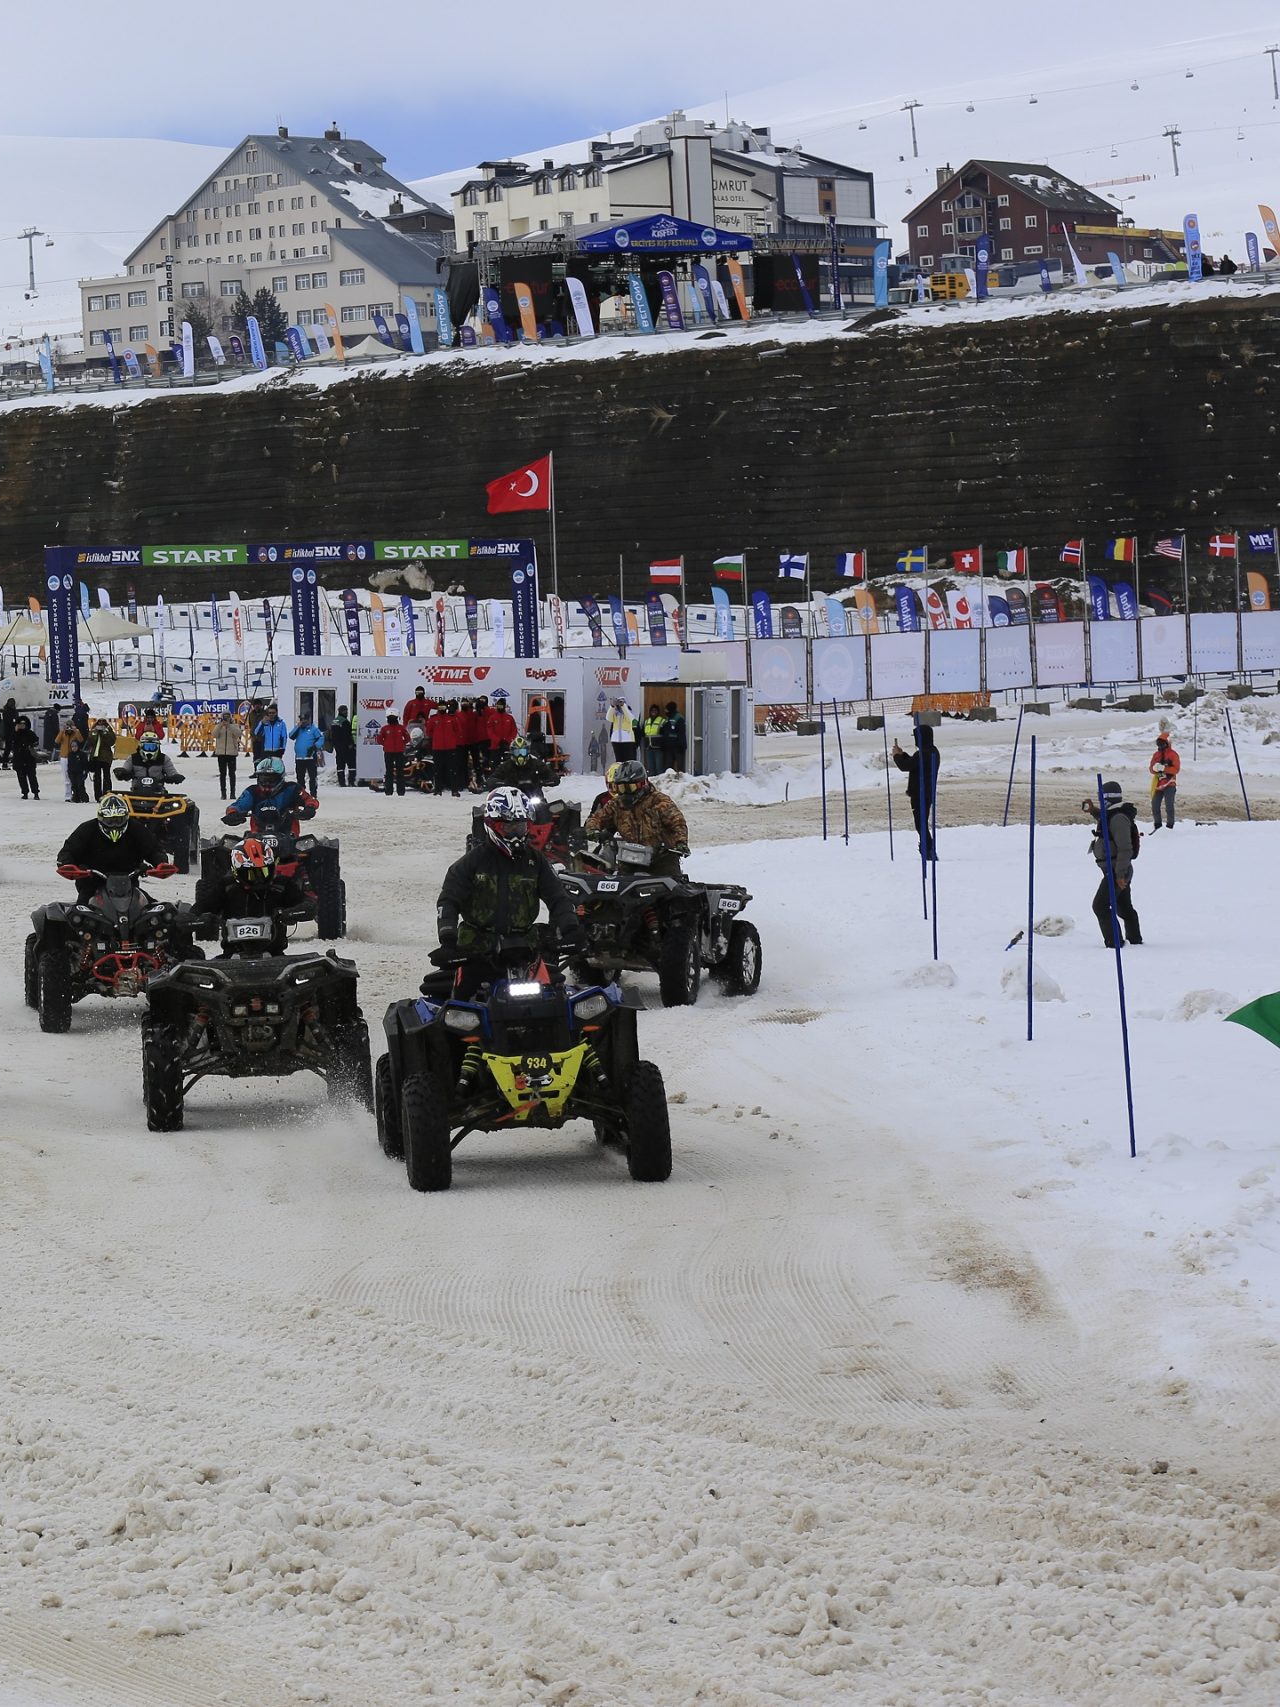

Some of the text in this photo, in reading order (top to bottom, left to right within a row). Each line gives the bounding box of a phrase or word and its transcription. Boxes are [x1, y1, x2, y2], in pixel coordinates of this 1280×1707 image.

[713, 179, 747, 191] ÜMRÜT
[315, 546, 341, 557] SNX
[383, 545, 460, 559] START
[497, 543, 520, 554] SNX
[112, 550, 140, 562] SNX
[152, 549, 238, 564] START
[293, 665, 333, 677] TÜRKİYE
[440, 668, 469, 680] TMF
[525, 667, 558, 682] Erciyes
[603, 669, 620, 682] TMF
[600, 882, 616, 890] 866
[721, 900, 737, 909] 866
[238, 926, 259, 936] 826
[526, 1057, 547, 1069] 934
